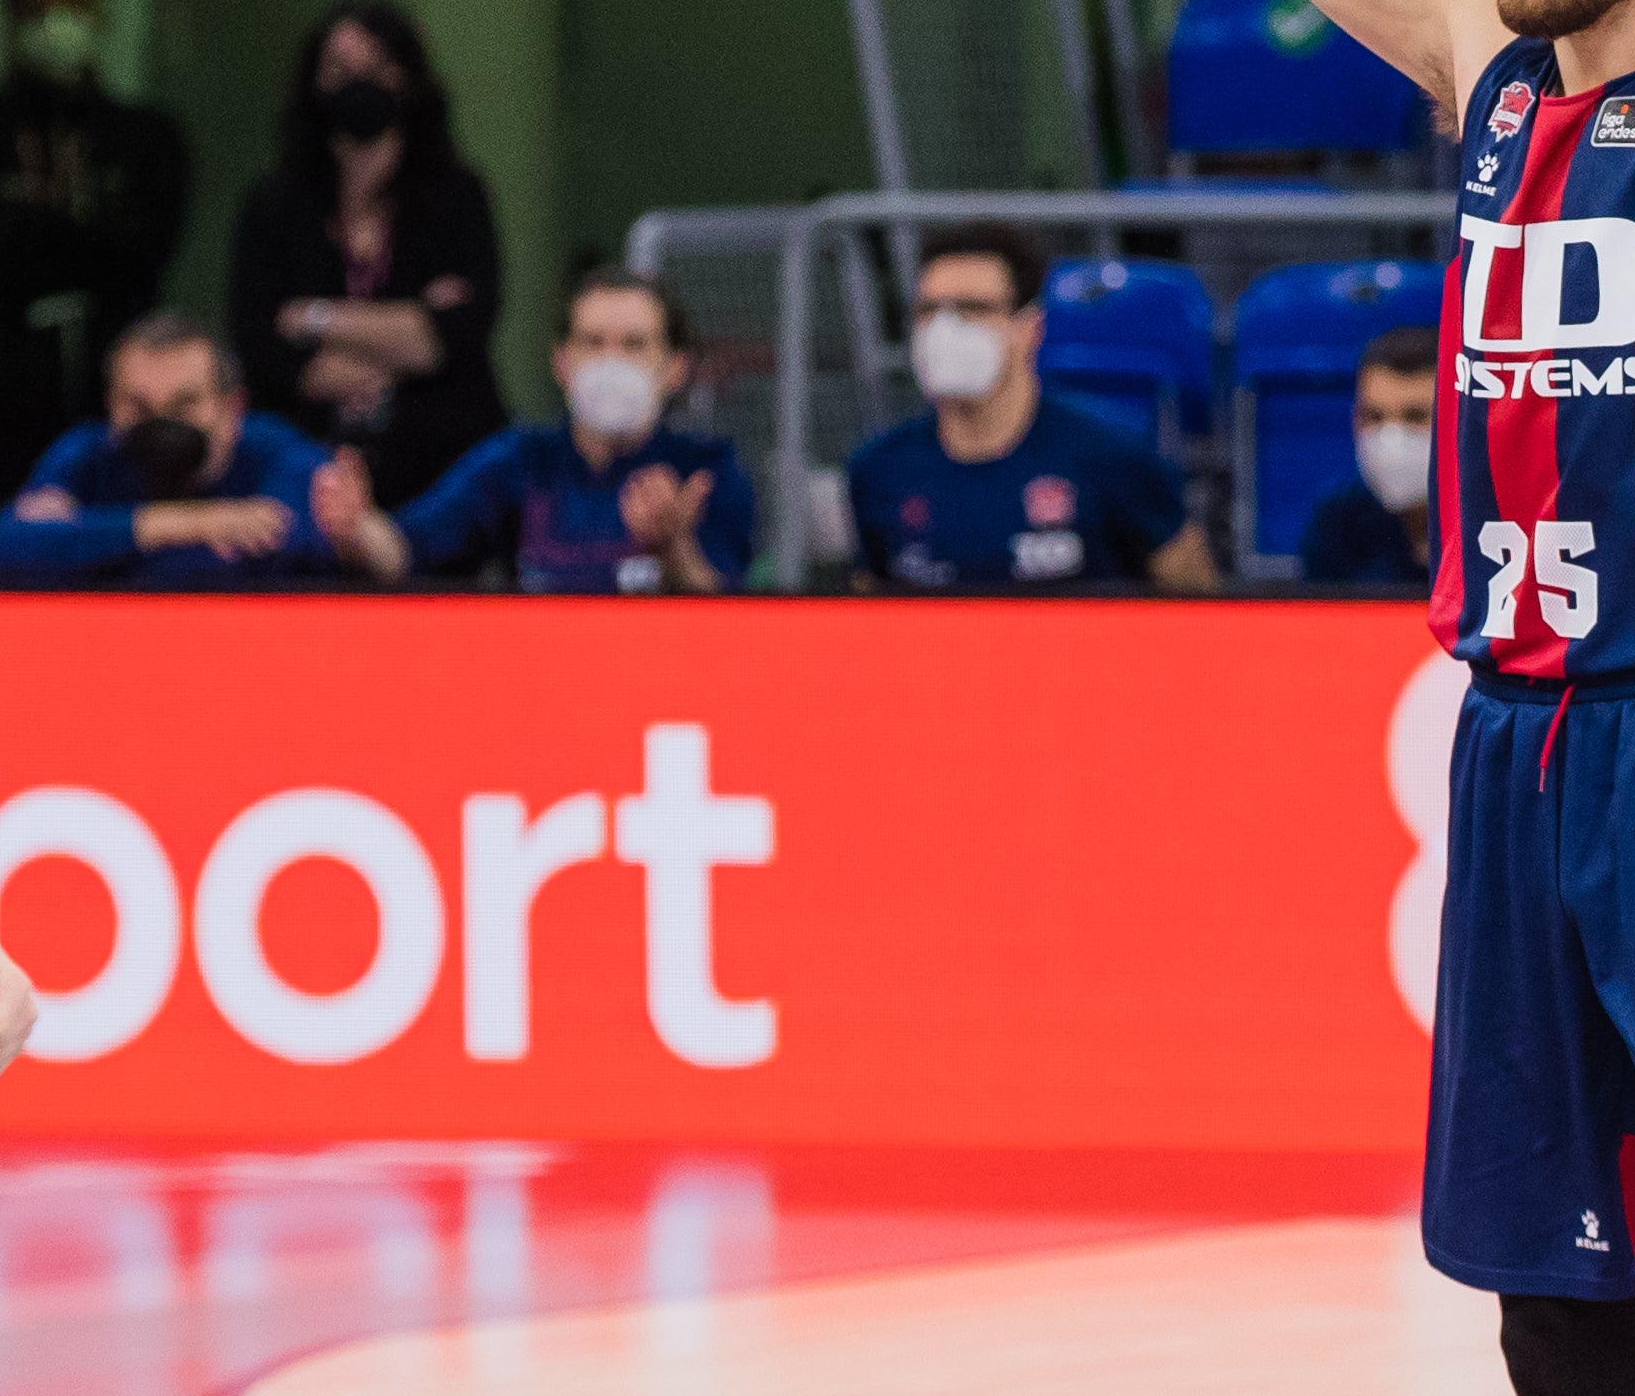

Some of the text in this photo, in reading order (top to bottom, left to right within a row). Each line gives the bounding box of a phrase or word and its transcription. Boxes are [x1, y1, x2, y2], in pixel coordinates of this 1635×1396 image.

[1601, 111, 1626, 127] liga
[1465, 180, 1498, 197] KELME
[1477, 520, 1599, 640] 25
[1575, 1236, 1611, 1252] KELME
